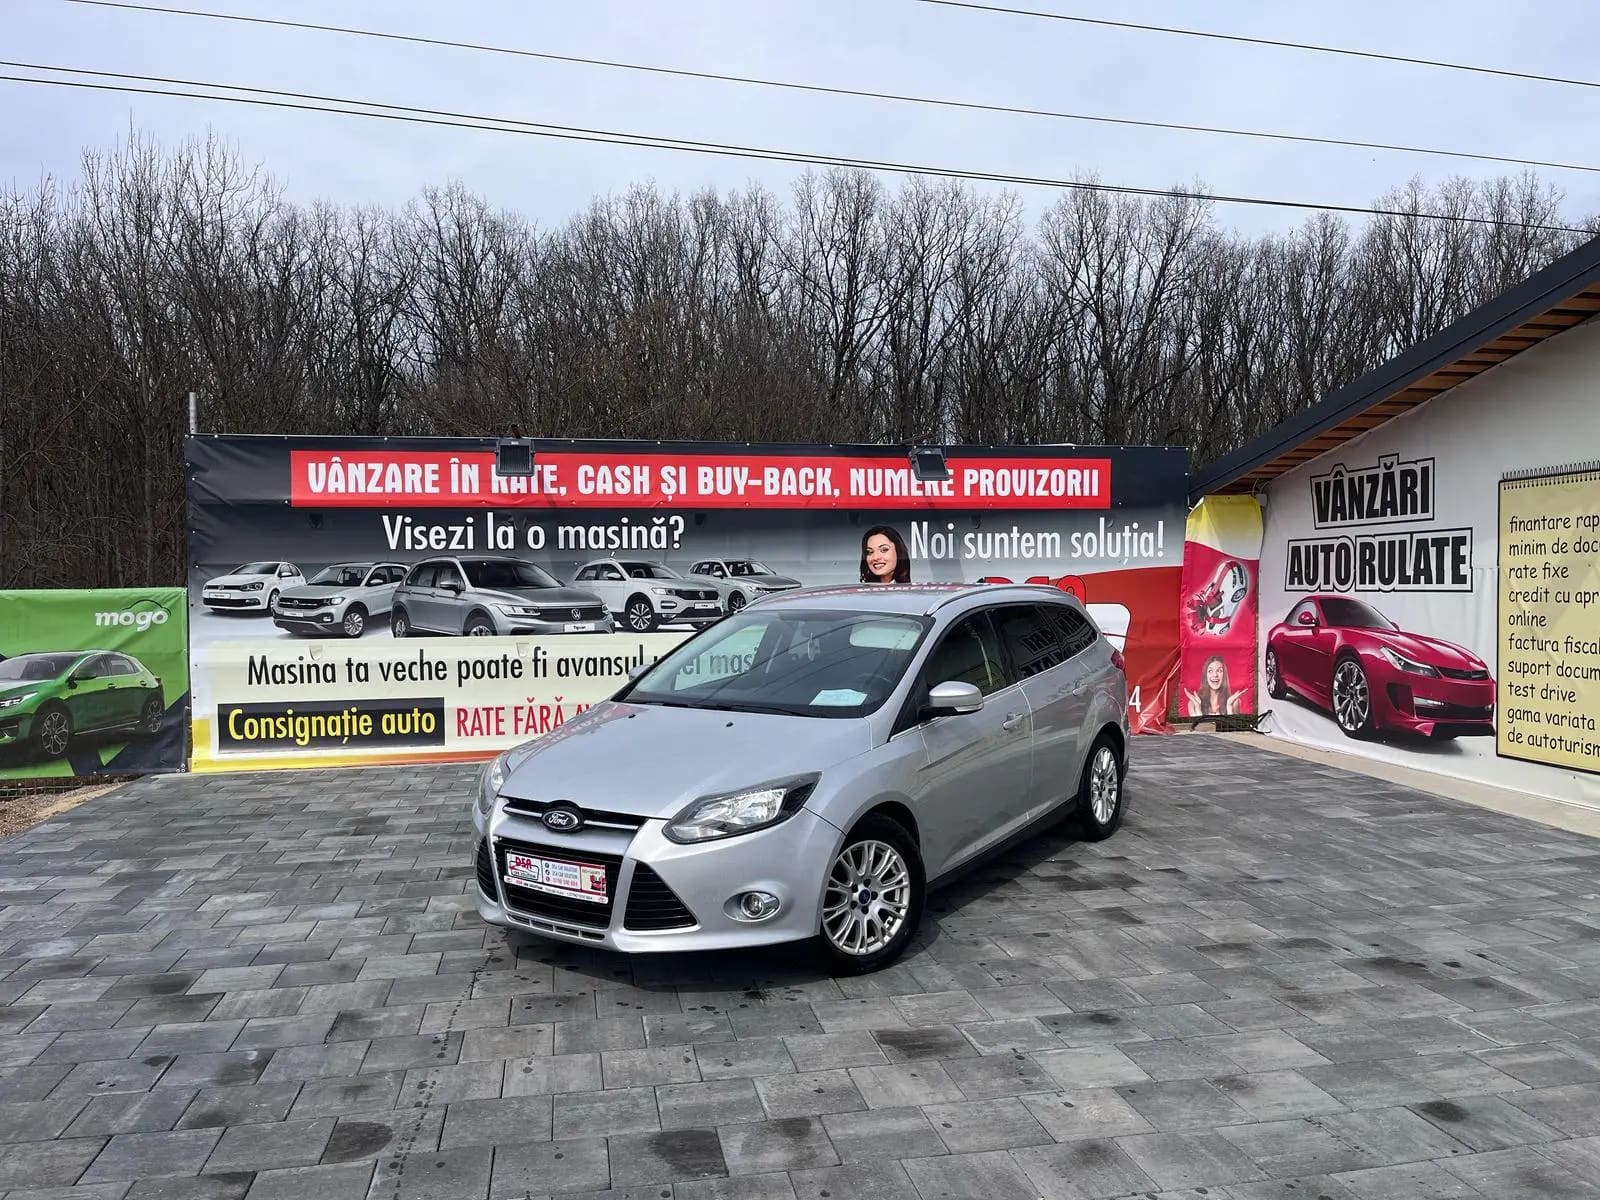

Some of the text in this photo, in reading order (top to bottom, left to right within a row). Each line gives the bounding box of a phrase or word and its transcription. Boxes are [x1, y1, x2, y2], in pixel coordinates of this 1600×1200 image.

[307, 457, 1099, 502] VÂNZARE ÎN RATE, CASH ȘI BUY-BACK, NUMERE PROVIZORII
[1314, 461, 1430, 523] VÂNZĂRI
[382, 515, 474, 550] Visezi
[487, 512, 516, 550] la
[527, 525, 546, 550] o
[1509, 516, 1571, 533] finantare
[911, 517, 1164, 565] Noi suntem soluția!
[1509, 536, 1600, 556] minim de doc
[1288, 536, 1467, 586] AUTO RULATE
[1509, 562, 1569, 579] rate fixe
[1509, 586, 1550, 603] credit
[1555, 591, 1570, 603] cu
[95, 609, 169, 632] mogo
[1508, 610, 1547, 627] online
[1508, 633, 1559, 652] factura
[248, 655, 337, 685] Masina
[346, 657, 369, 683] ta
[379, 649, 447, 681] veche
[457, 652, 523, 688] poate
[532, 646, 548, 678] fi
[1508, 660, 1551, 678] suport
[1129, 686, 1142, 713] 4
[1508, 682, 1577, 703] test drive
[228, 707, 436, 746] Consignație auto
[457, 706, 505, 737] RATE
[514, 696, 564, 735] FĂRĂ
[1507, 708, 1596, 731] gama variata
[1507, 727, 1523, 743] de
[548, 812, 569, 825] Ford
